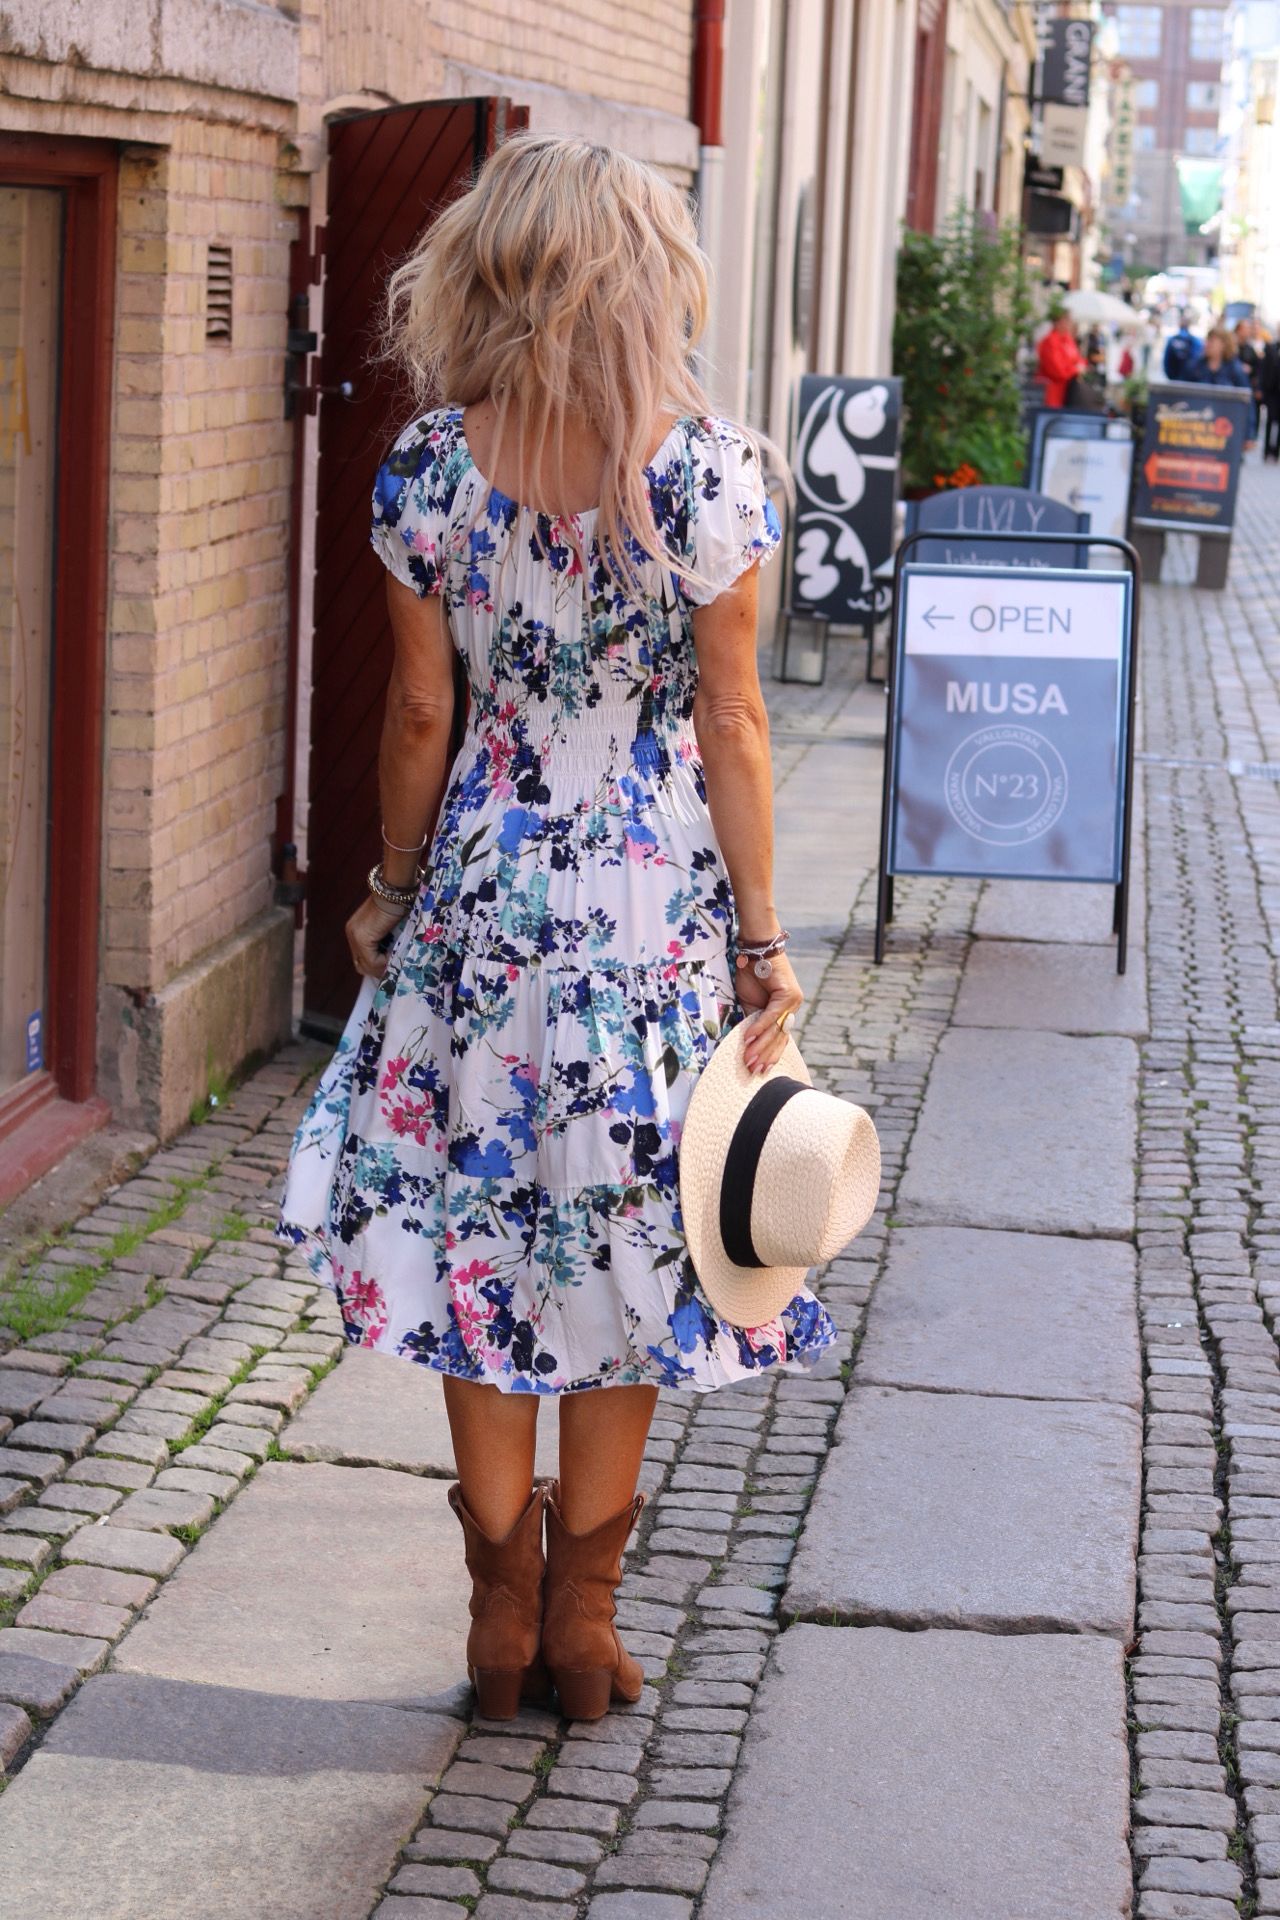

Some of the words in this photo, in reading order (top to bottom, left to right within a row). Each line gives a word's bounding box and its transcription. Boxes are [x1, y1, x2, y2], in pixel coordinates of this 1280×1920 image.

[969, 604, 1072, 634] OPEN
[945, 681, 1069, 716] MUSA
[974, 730, 1041, 749] VALLGATAN
[950, 772, 982, 832] VALLGATAN
[1026, 775, 1063, 834] VALLGATAN
